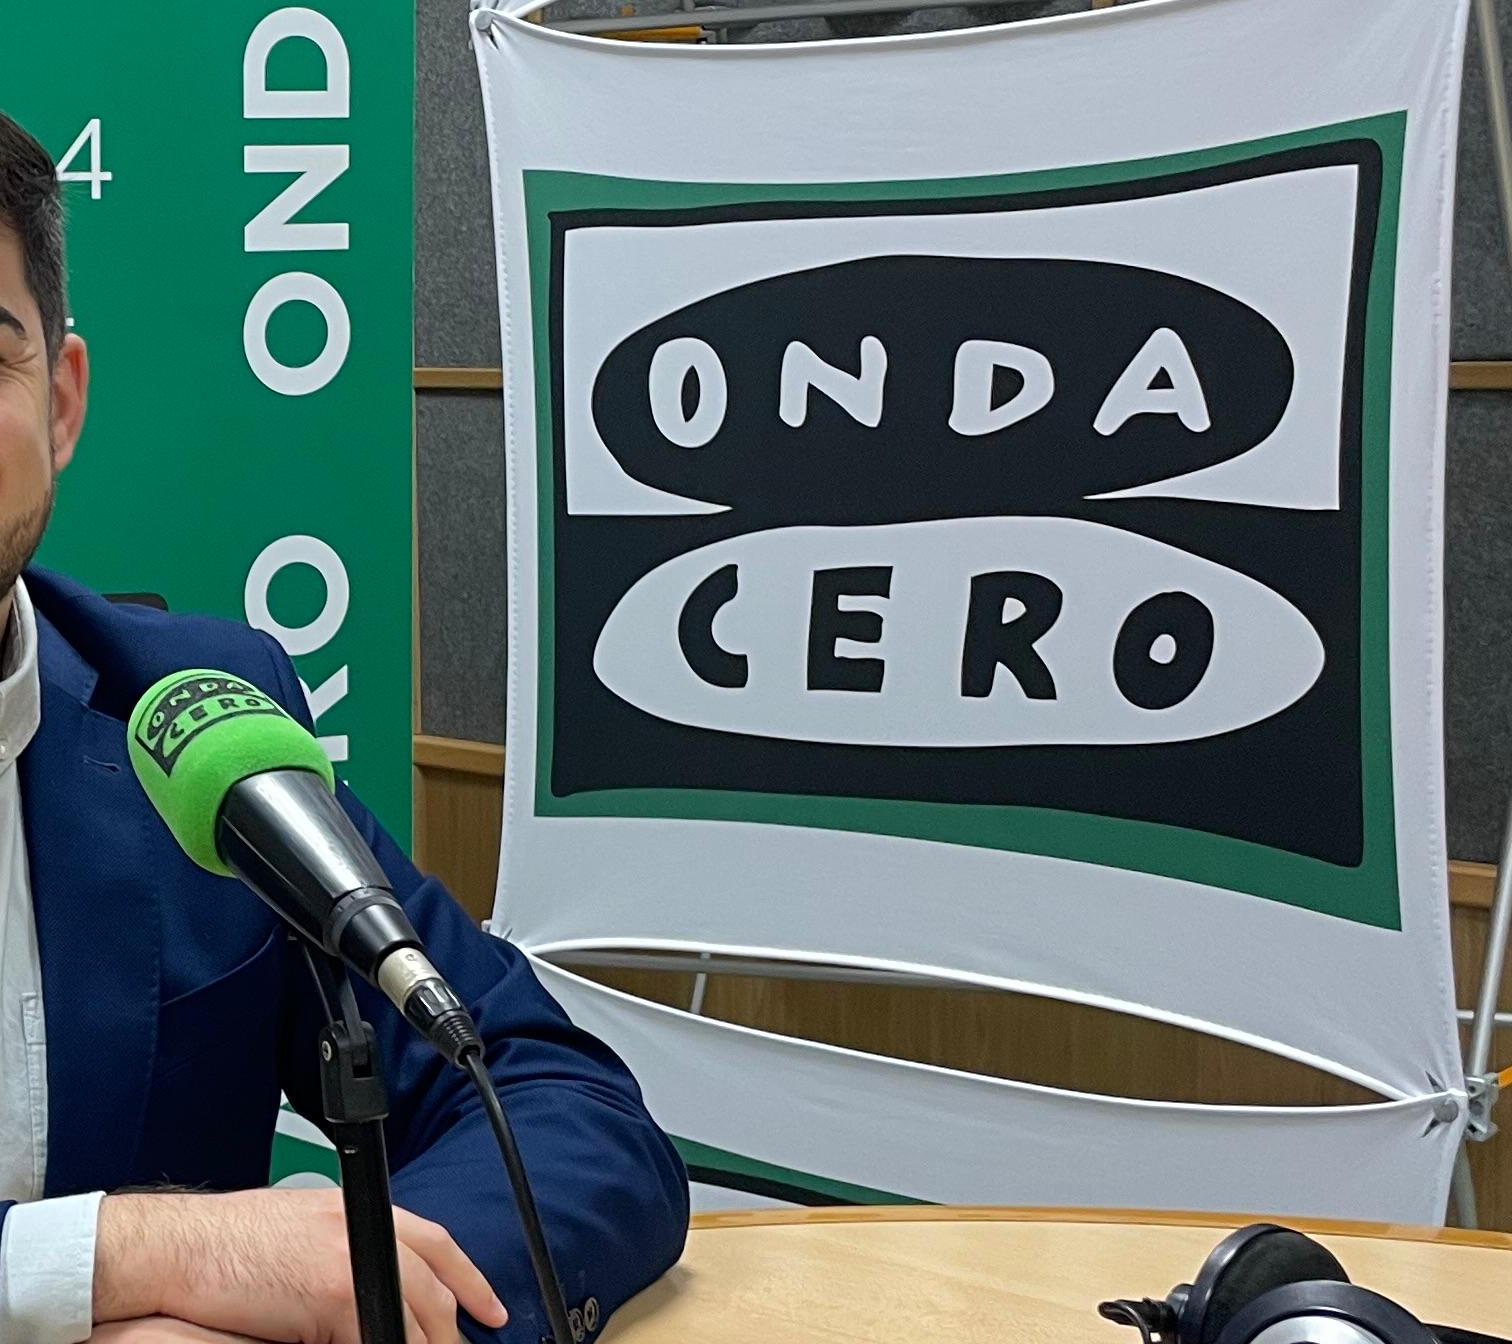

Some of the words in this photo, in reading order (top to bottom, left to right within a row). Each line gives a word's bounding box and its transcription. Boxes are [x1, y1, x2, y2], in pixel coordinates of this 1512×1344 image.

[647, 326, 1211, 449] ONDA
[677, 563, 1215, 711] CERO
[169, 698, 261, 739] CERO
